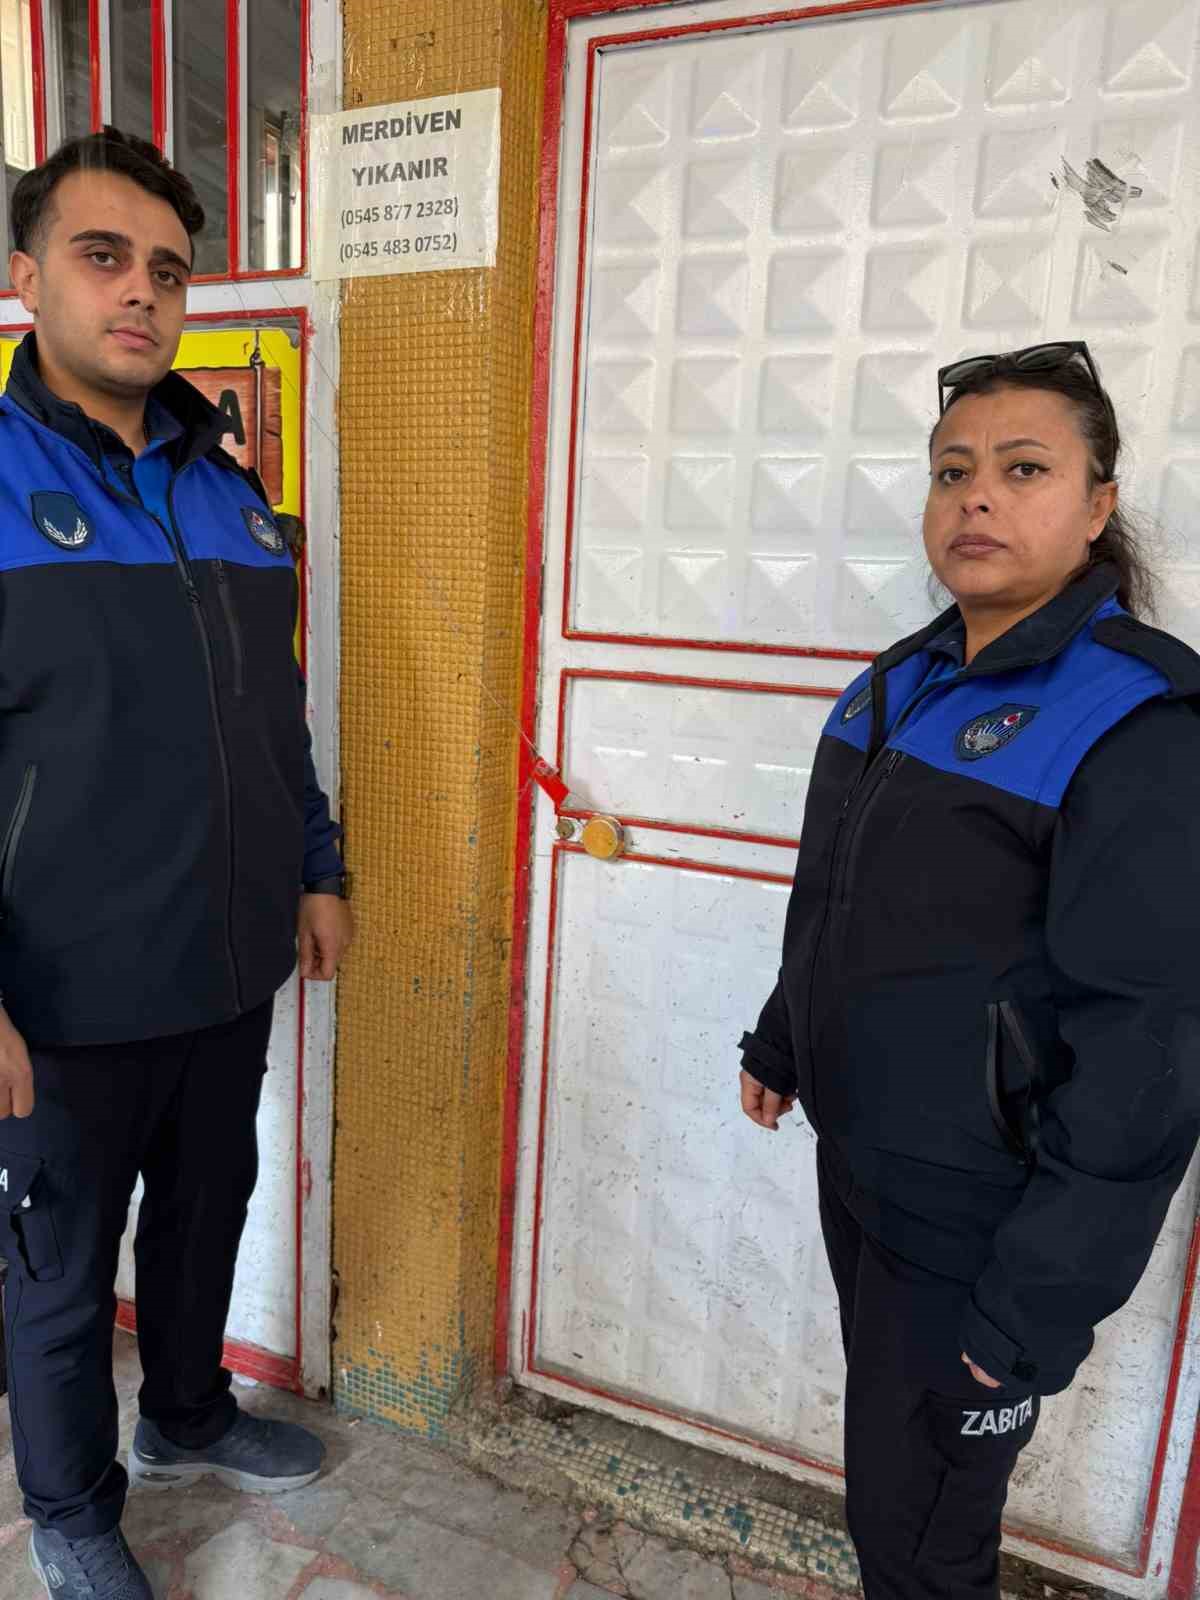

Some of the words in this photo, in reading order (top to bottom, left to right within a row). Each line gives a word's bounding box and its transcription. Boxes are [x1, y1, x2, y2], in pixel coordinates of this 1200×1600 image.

[342, 109, 462, 145] MERDİVEN
[352, 157, 448, 186] YIKANIR
[341, 207, 380, 229] (0545
[384, 204, 412, 221] 877
[416, 197, 459, 218] 2328)
[340, 242, 378, 263] (0545
[383, 239, 410, 255] 483
[415, 232, 457, 253] 0752)
[961, 1395, 1033, 1435] ZABITA
